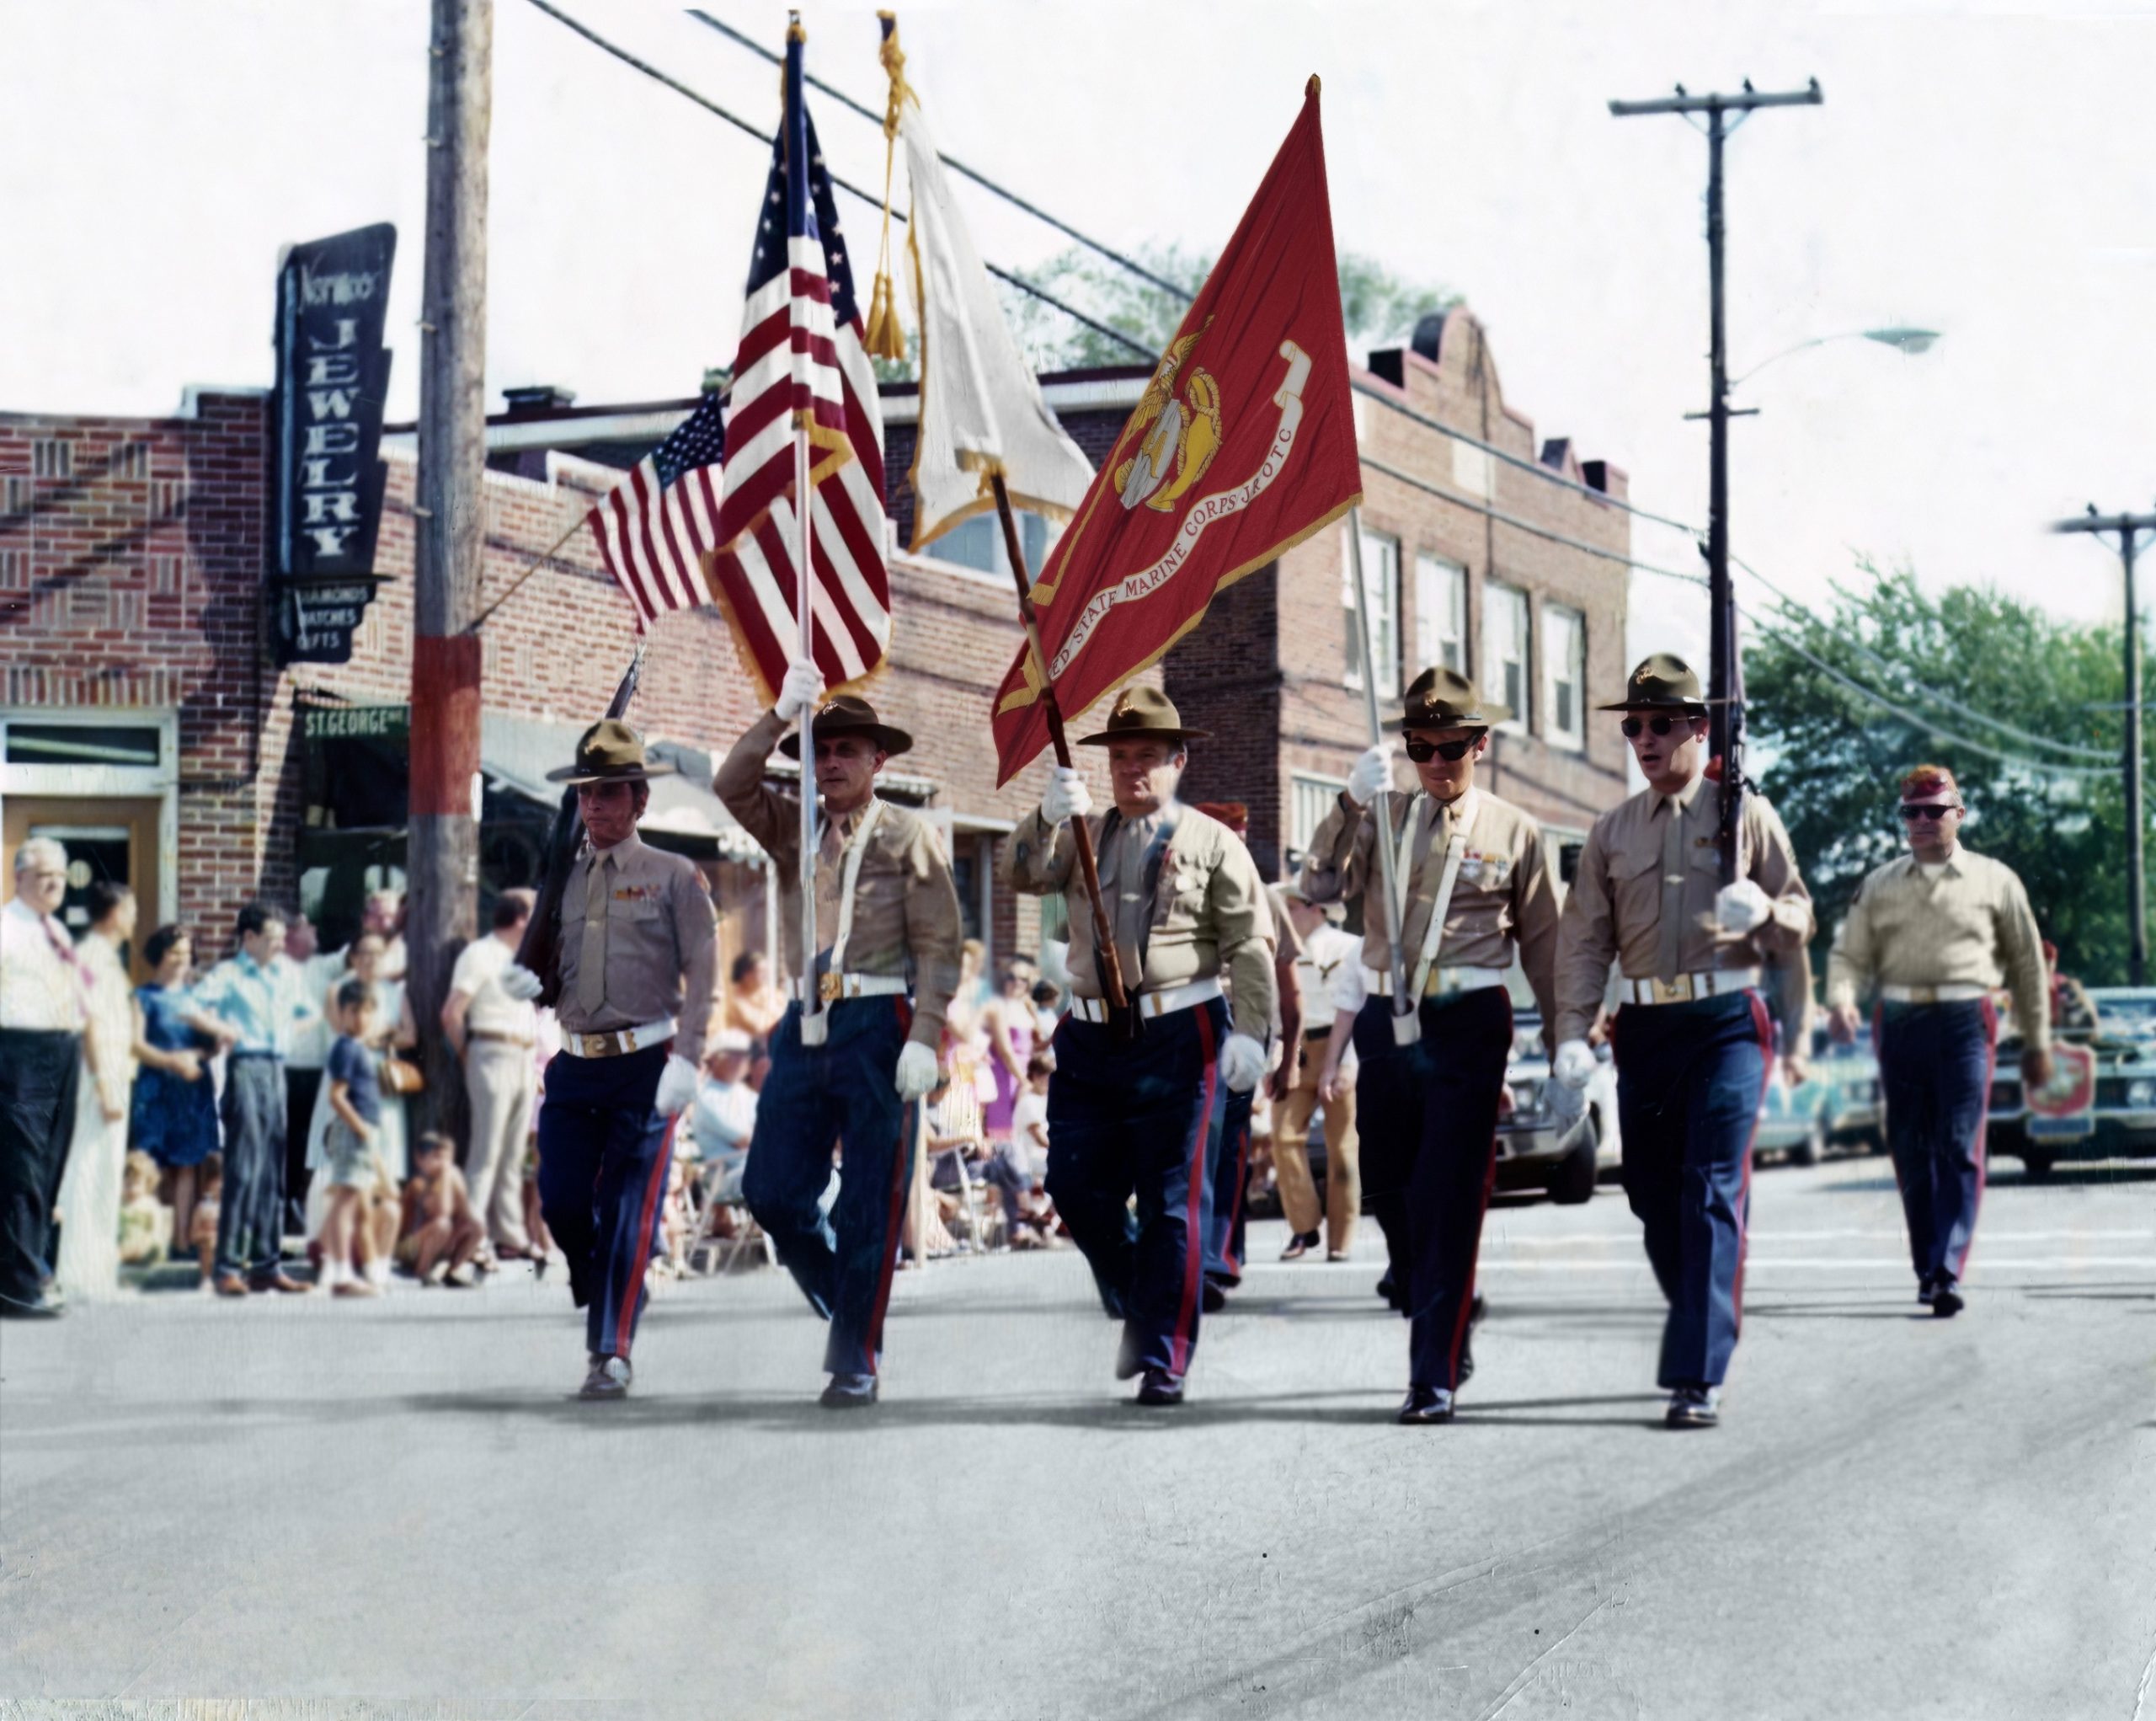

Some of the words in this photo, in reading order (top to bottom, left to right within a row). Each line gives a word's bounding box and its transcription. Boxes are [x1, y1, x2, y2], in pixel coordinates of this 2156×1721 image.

[302, 318, 360, 557] JEWELRY
[1125, 542, 1187, 598] MARINE
[1185, 494, 1236, 537] CORPS
